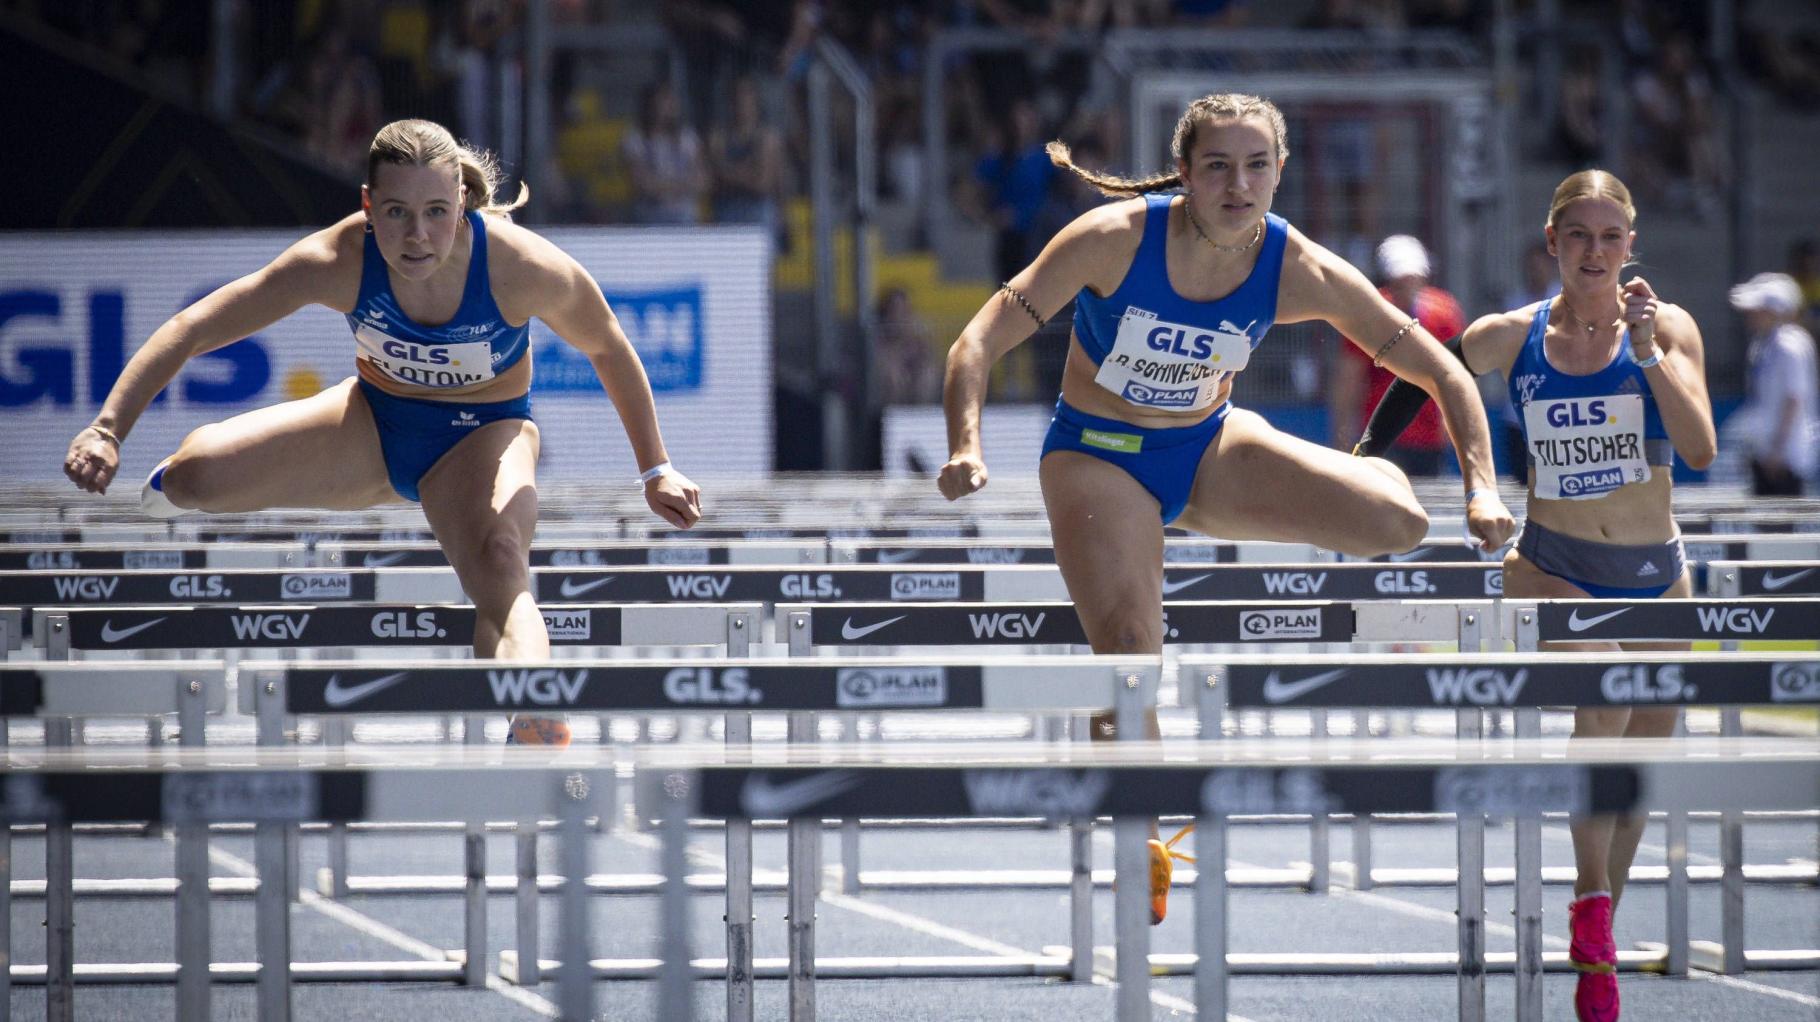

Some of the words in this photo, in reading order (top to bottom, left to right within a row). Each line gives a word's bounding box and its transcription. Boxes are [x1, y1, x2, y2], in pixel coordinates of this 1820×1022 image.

[382, 340, 461, 368] GLS.
[1146, 326, 1221, 363] GLS.
[1153, 391, 1195, 401] PLAN
[1546, 401, 1617, 428] GLS.
[1534, 432, 1641, 467] TILTSCHER
[1583, 471, 1621, 488] PLAN
[54, 577, 119, 599] WGV
[169, 575, 231, 598] GLS.
[309, 577, 348, 588] PLAN
[666, 574, 732, 598] WGV
[780, 573, 842, 598] GLS.
[919, 579, 956, 590] PLAN
[1262, 571, 1328, 594] WGV
[1374, 570, 1437, 593] GLS.
[231, 613, 310, 640] WGV
[370, 611, 447, 639] GLS.
[968, 612, 1046, 639] WGV
[1273, 614, 1317, 629] PLAN
[1697, 606, 1775, 634] WGV
[487, 668, 590, 705] WGV
[663, 667, 763, 705] GLS.
[1425, 667, 1529, 704] WGV
[1600, 664, 1698, 704] GLS.
